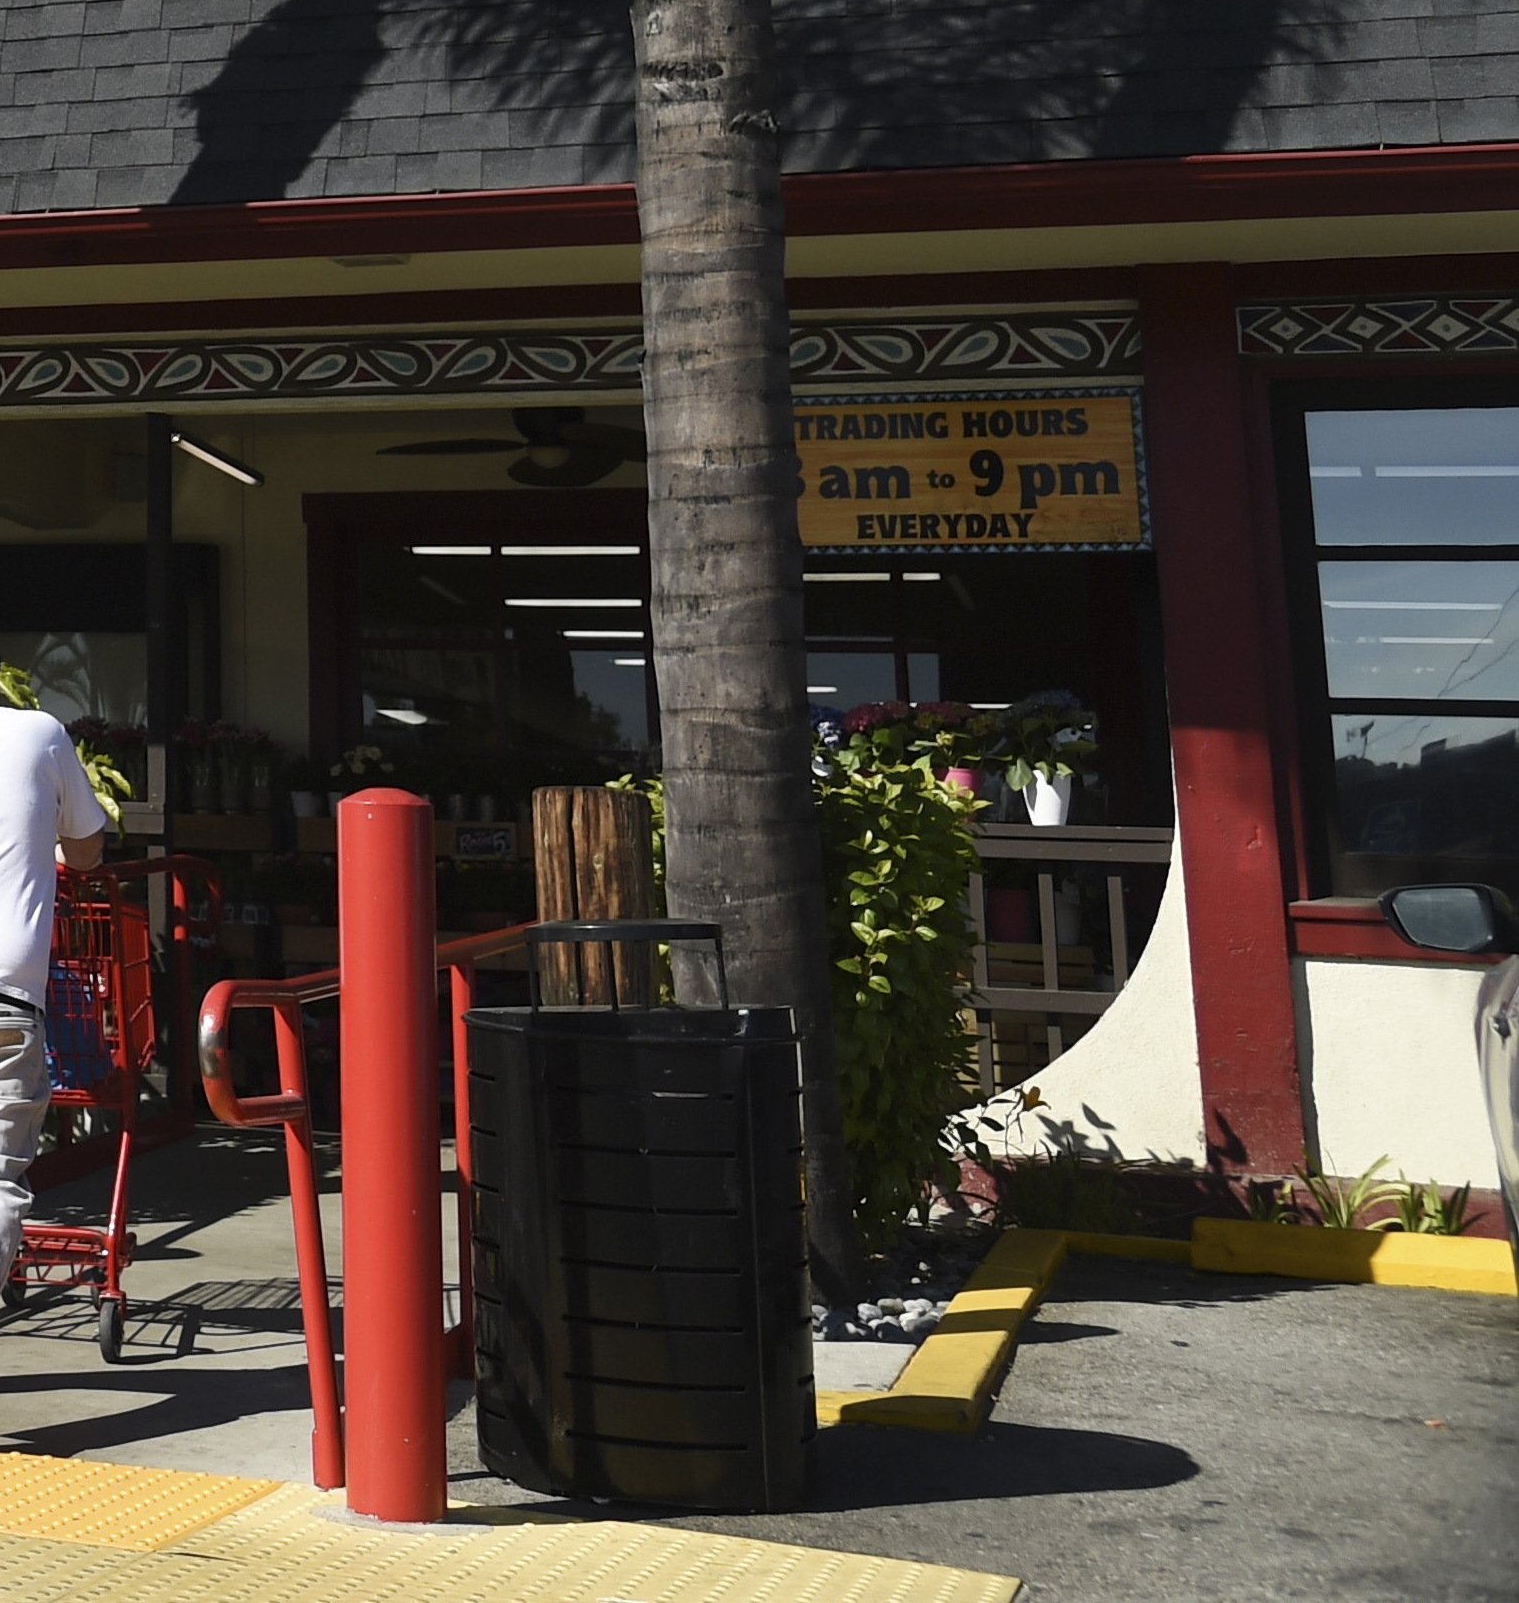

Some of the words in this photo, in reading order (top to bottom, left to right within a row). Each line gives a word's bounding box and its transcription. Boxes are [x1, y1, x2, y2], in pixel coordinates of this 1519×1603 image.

[795, 412, 949, 440] TRADING
[962, 407, 1089, 438] HOURS
[819, 465, 911, 499] am
[926, 469, 956, 489] to
[969, 449, 1005, 497] 9
[1017, 459, 1121, 510] pm
[856, 511, 1037, 540] EVERYDAY
